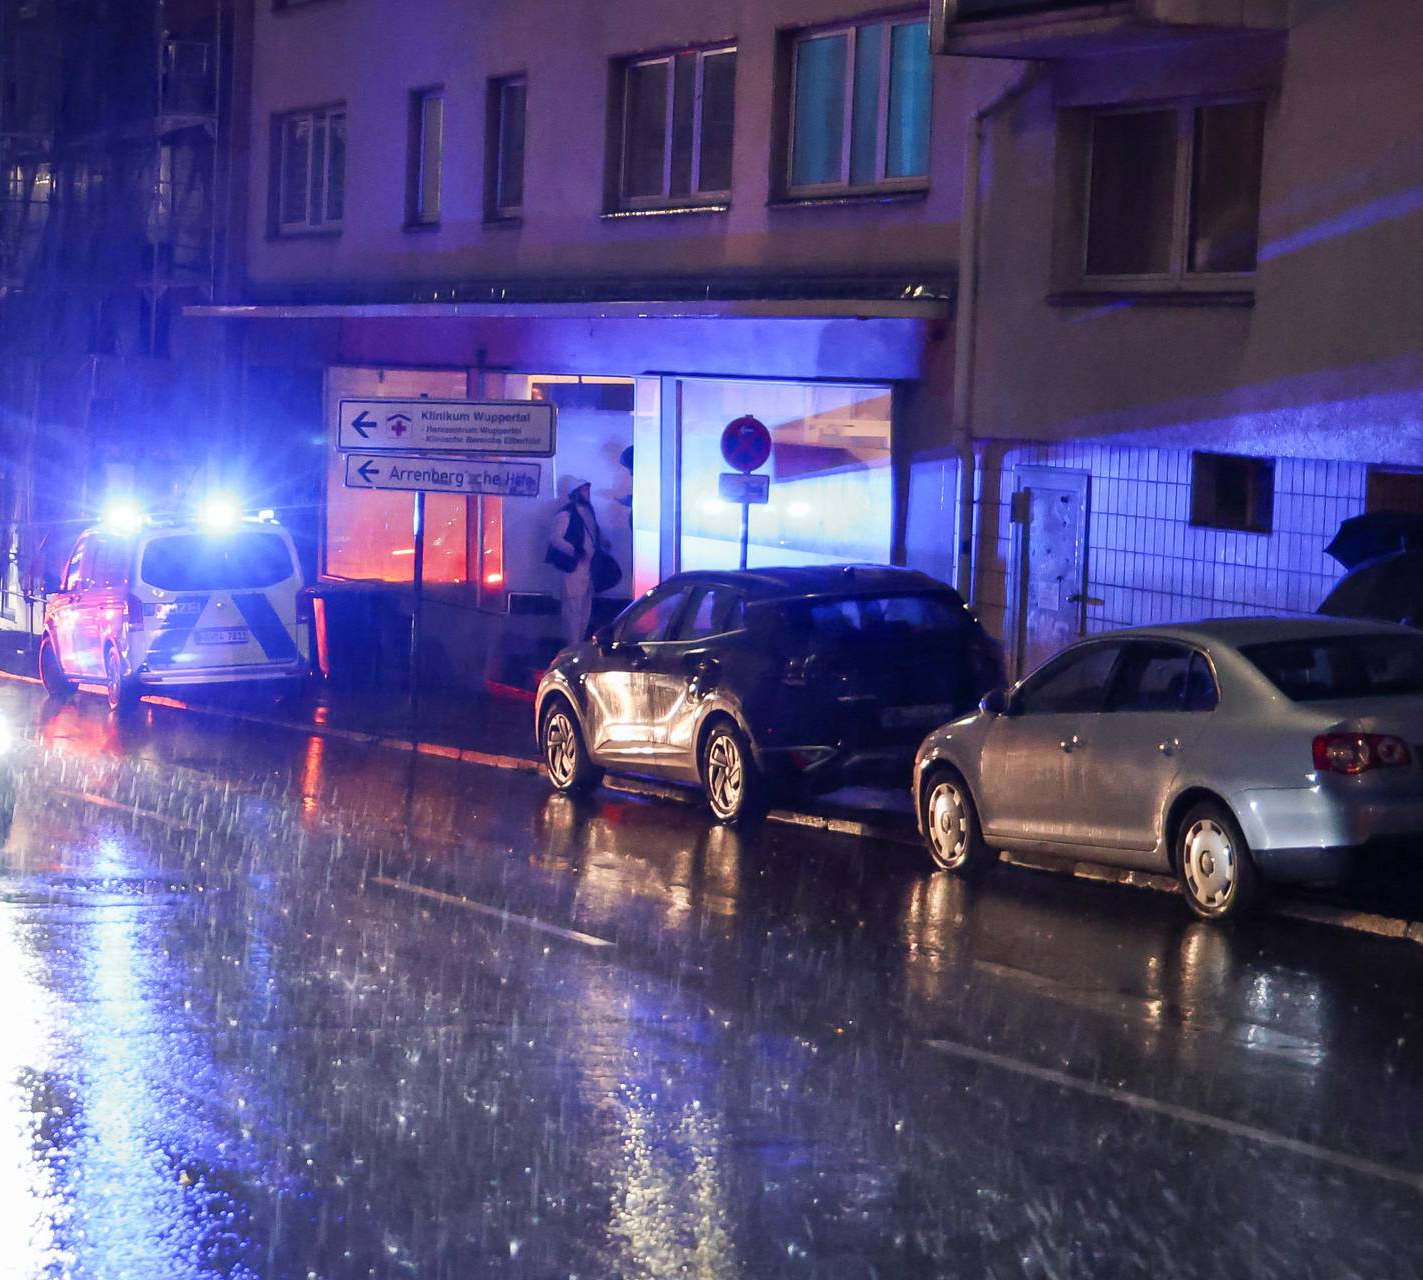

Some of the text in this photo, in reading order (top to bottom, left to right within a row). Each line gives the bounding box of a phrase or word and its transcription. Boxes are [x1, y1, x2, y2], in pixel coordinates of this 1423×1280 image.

[421, 410, 531, 425] Klinikum Wuppertal
[389, 465, 501, 488] Arrenberg'che
